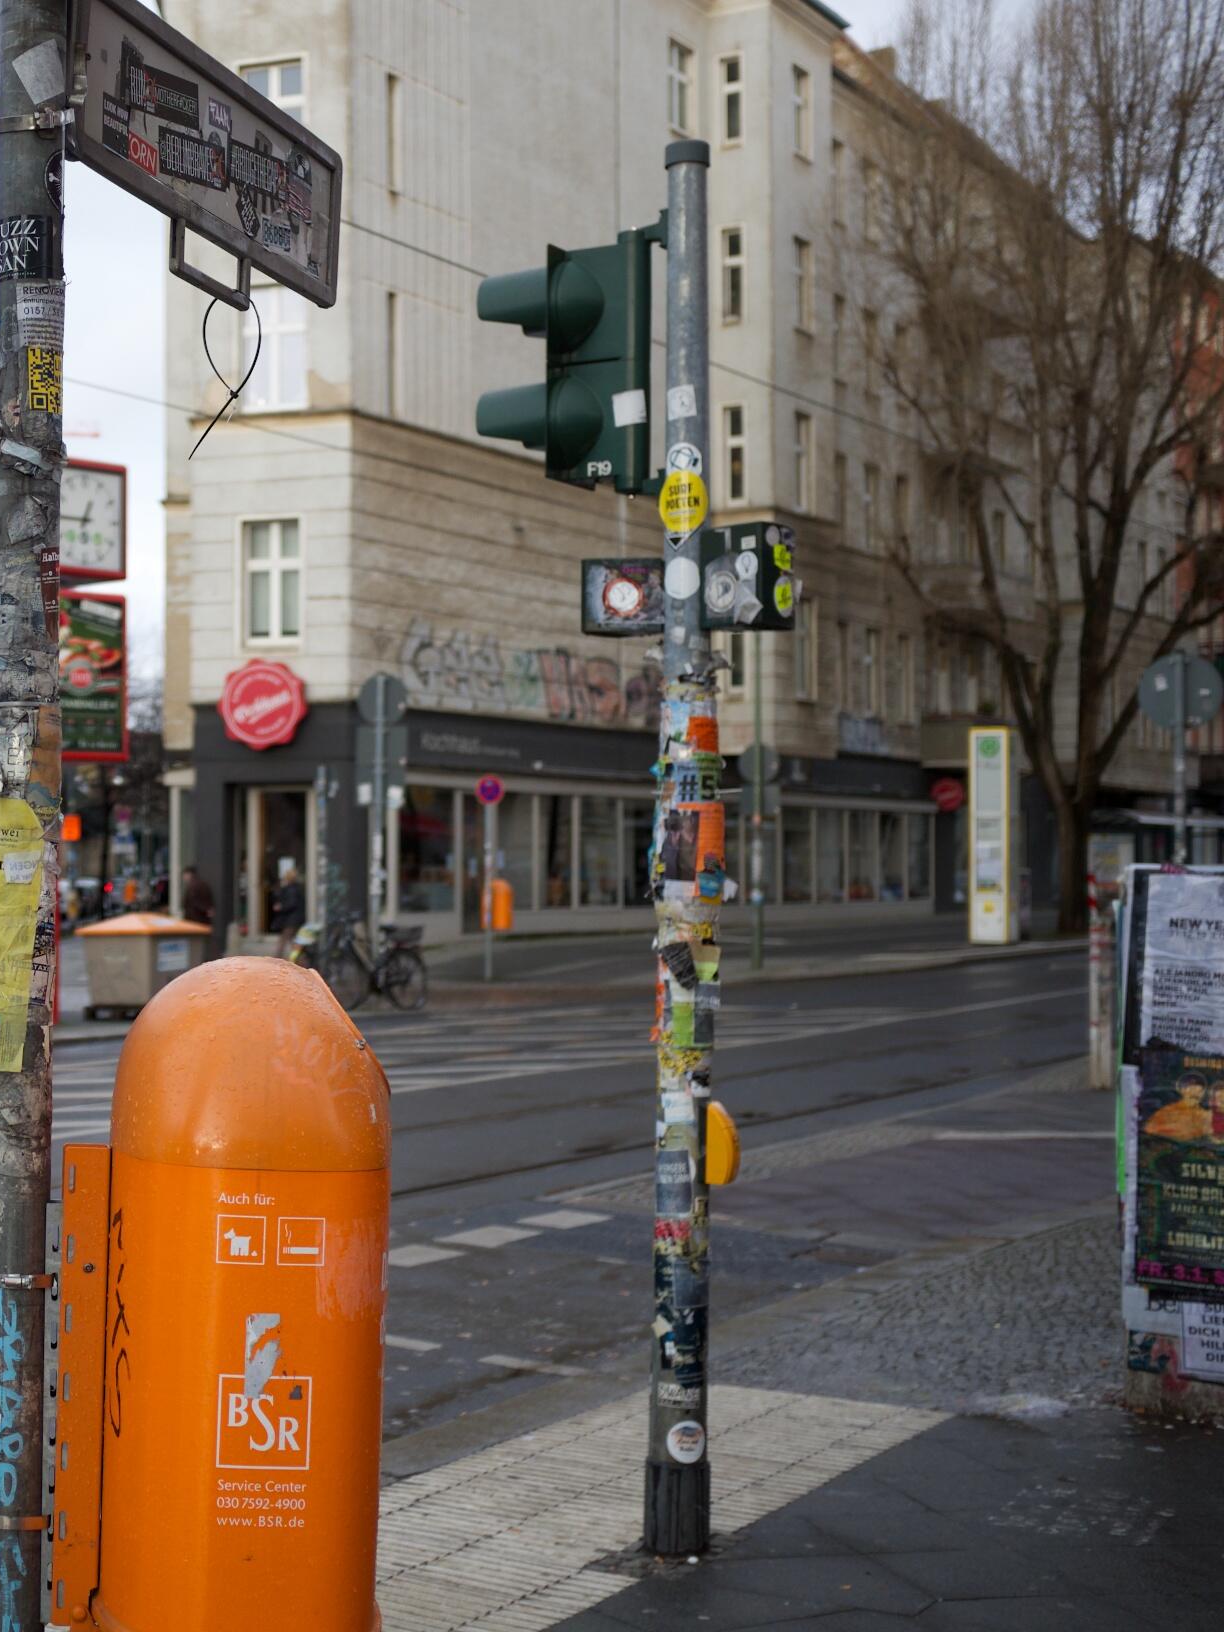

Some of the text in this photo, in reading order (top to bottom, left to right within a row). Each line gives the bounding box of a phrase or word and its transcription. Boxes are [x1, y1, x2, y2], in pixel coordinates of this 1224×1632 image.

[128, 134, 156, 173] ORN
[23, 306, 45, 316] 0157
[587, 460, 612, 476] F19
[1169, 917, 1202, 930] NEW
[218, 1192, 276, 1206] Auch für:
[1188, 1326, 1220, 1337] DICH
[226, 1392, 300, 1452] BSR
[217, 1479, 307, 1493] Service Center
[216, 1496, 306, 1511] 030 7592-4900
[216, 1515, 305, 1529] www.BSR.de
